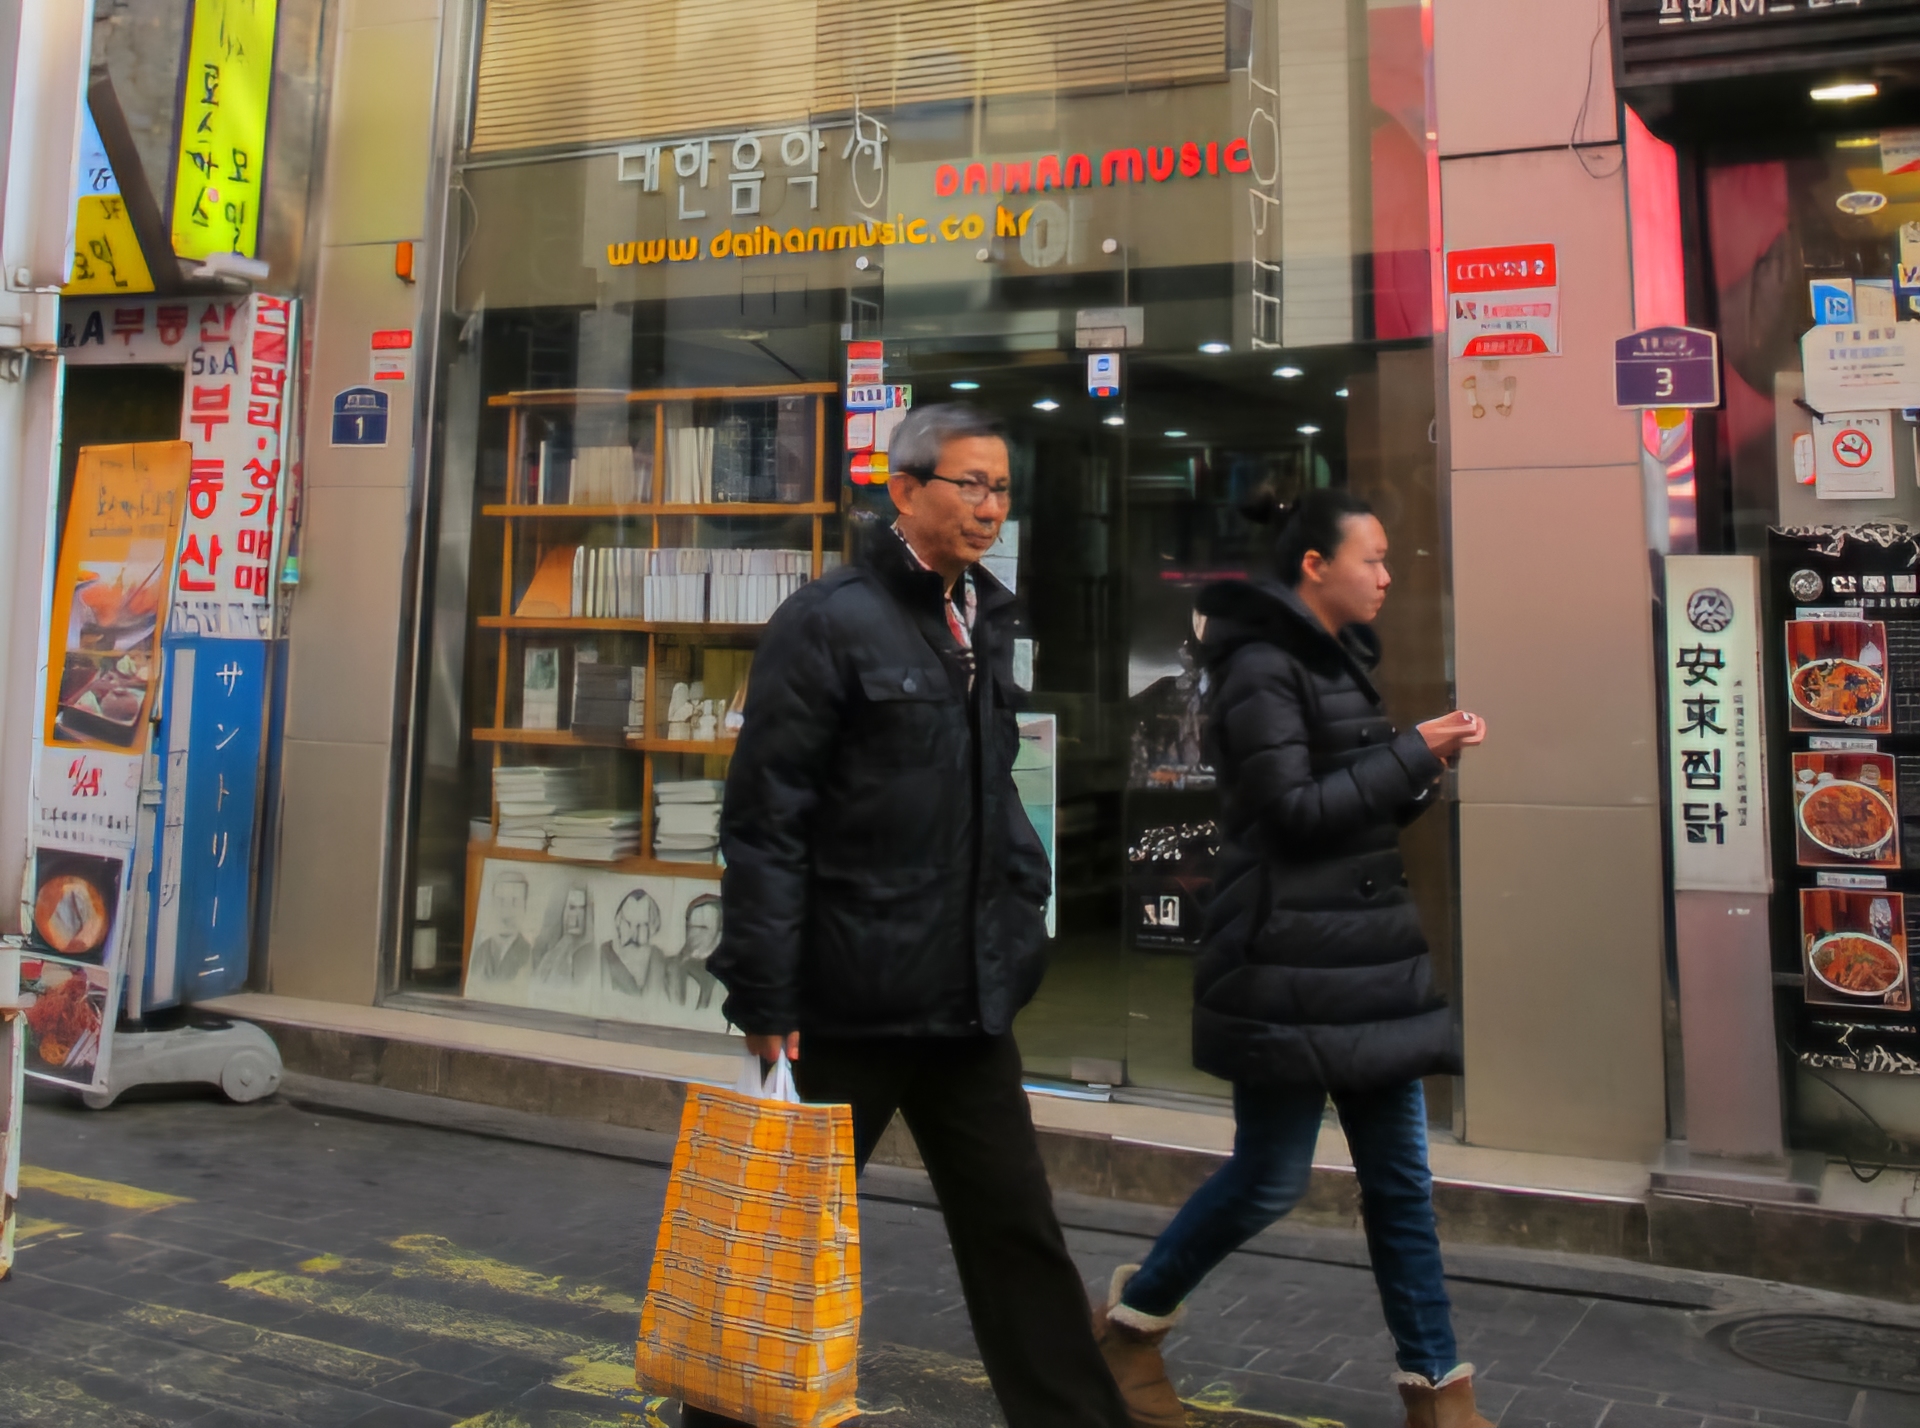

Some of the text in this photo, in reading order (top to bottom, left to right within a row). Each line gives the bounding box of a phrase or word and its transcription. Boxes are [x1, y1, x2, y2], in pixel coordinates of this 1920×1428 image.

[934, 137, 1251, 197] DAIHAN MUSIC
[112, 303, 237, 346] 부동산
[1655, 367, 1673, 397] 3
[355, 416, 364, 440] 1
[179, 384, 231, 592] 부동산
